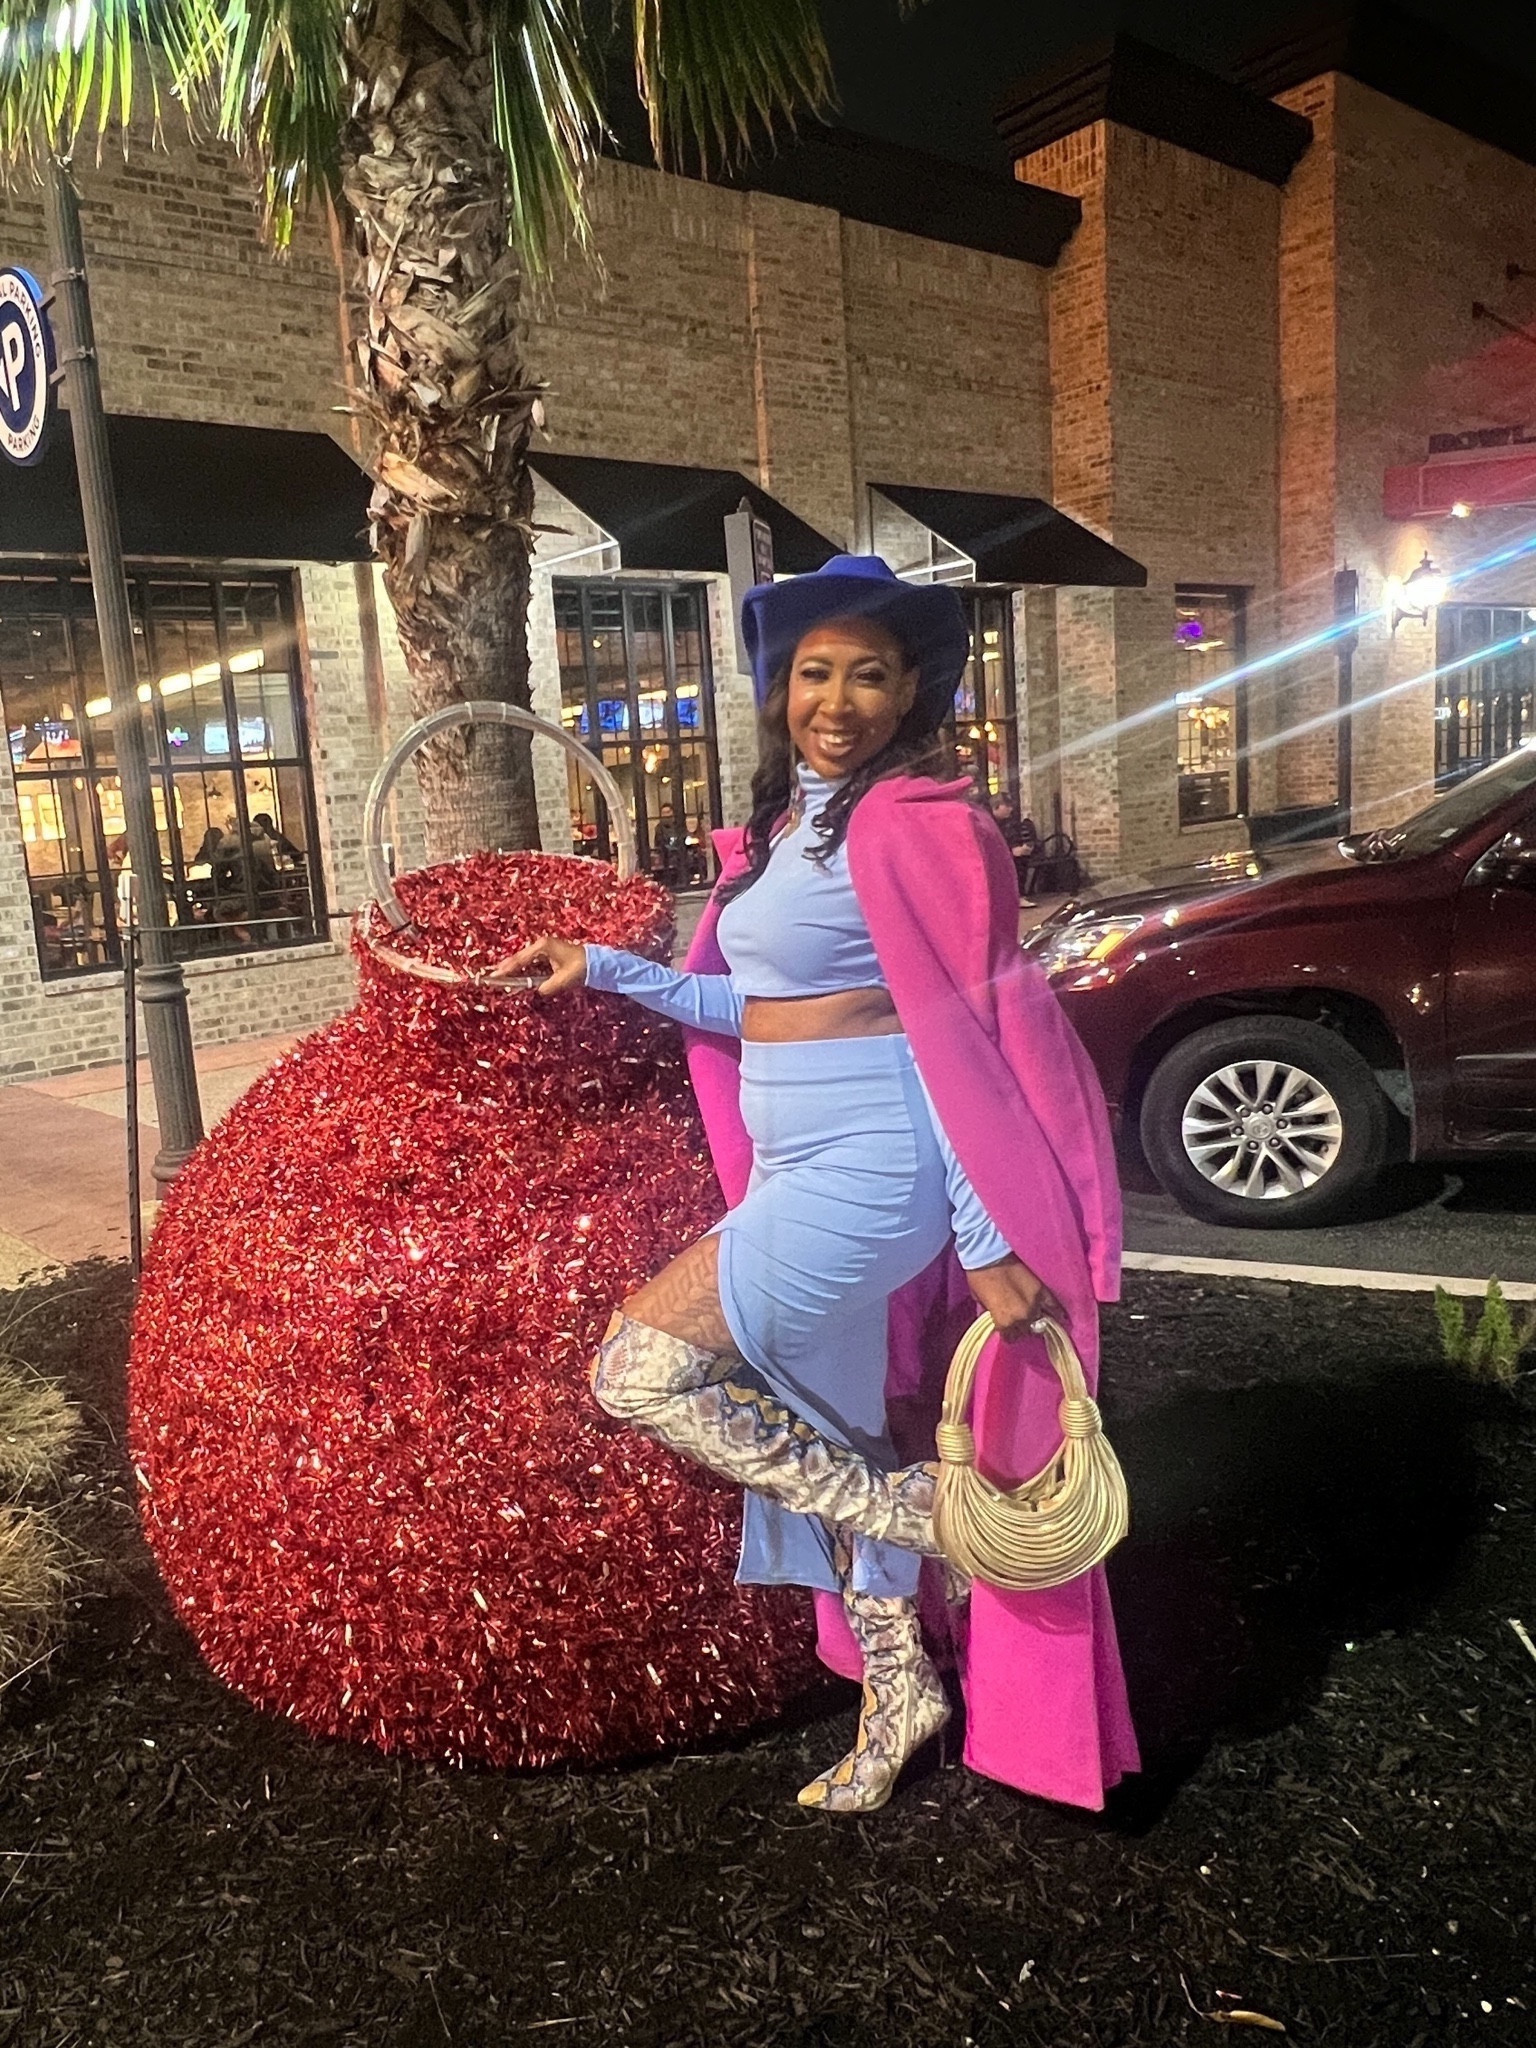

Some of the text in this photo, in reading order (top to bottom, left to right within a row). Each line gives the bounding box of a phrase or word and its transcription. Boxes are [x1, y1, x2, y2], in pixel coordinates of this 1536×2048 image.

[9, 281, 41, 358] PARKING
[2, 321, 25, 412] P
[8, 414, 40, 451] PARKING
